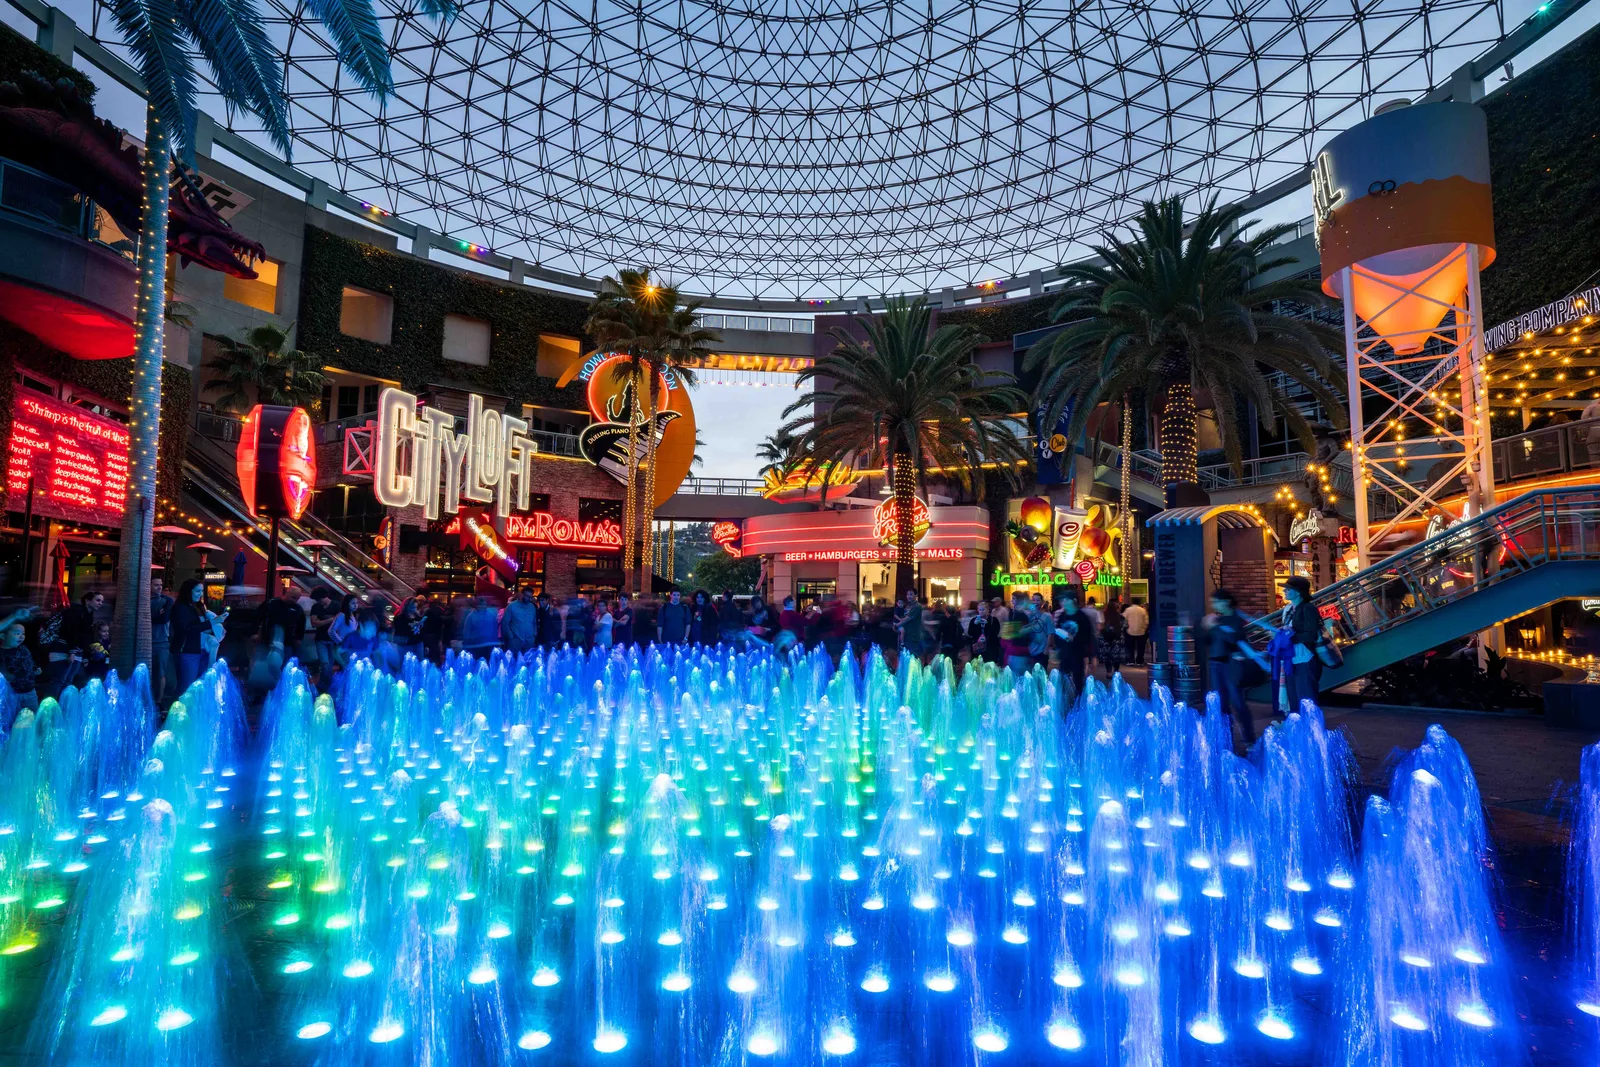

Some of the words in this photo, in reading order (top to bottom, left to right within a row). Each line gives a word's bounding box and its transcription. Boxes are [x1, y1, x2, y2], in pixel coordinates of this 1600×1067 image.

[580, 351, 607, 381] HOWL
[61, 412, 68, 424] is
[70, 415, 84, 431] the
[103, 428, 111, 438] of
[587, 428, 611, 445] DUELING
[56, 446, 76, 458] shrimp
[534, 511, 622, 545] ROMA'S
[785, 552, 807, 561] BEER
[814, 550, 880, 560] HAMBURGERS
[927, 549, 963, 558] MALTS
[1158, 533, 1177, 585] BREWER
[990, 568, 1069, 586] Jamba
[1095, 570, 1123, 587] Juice
